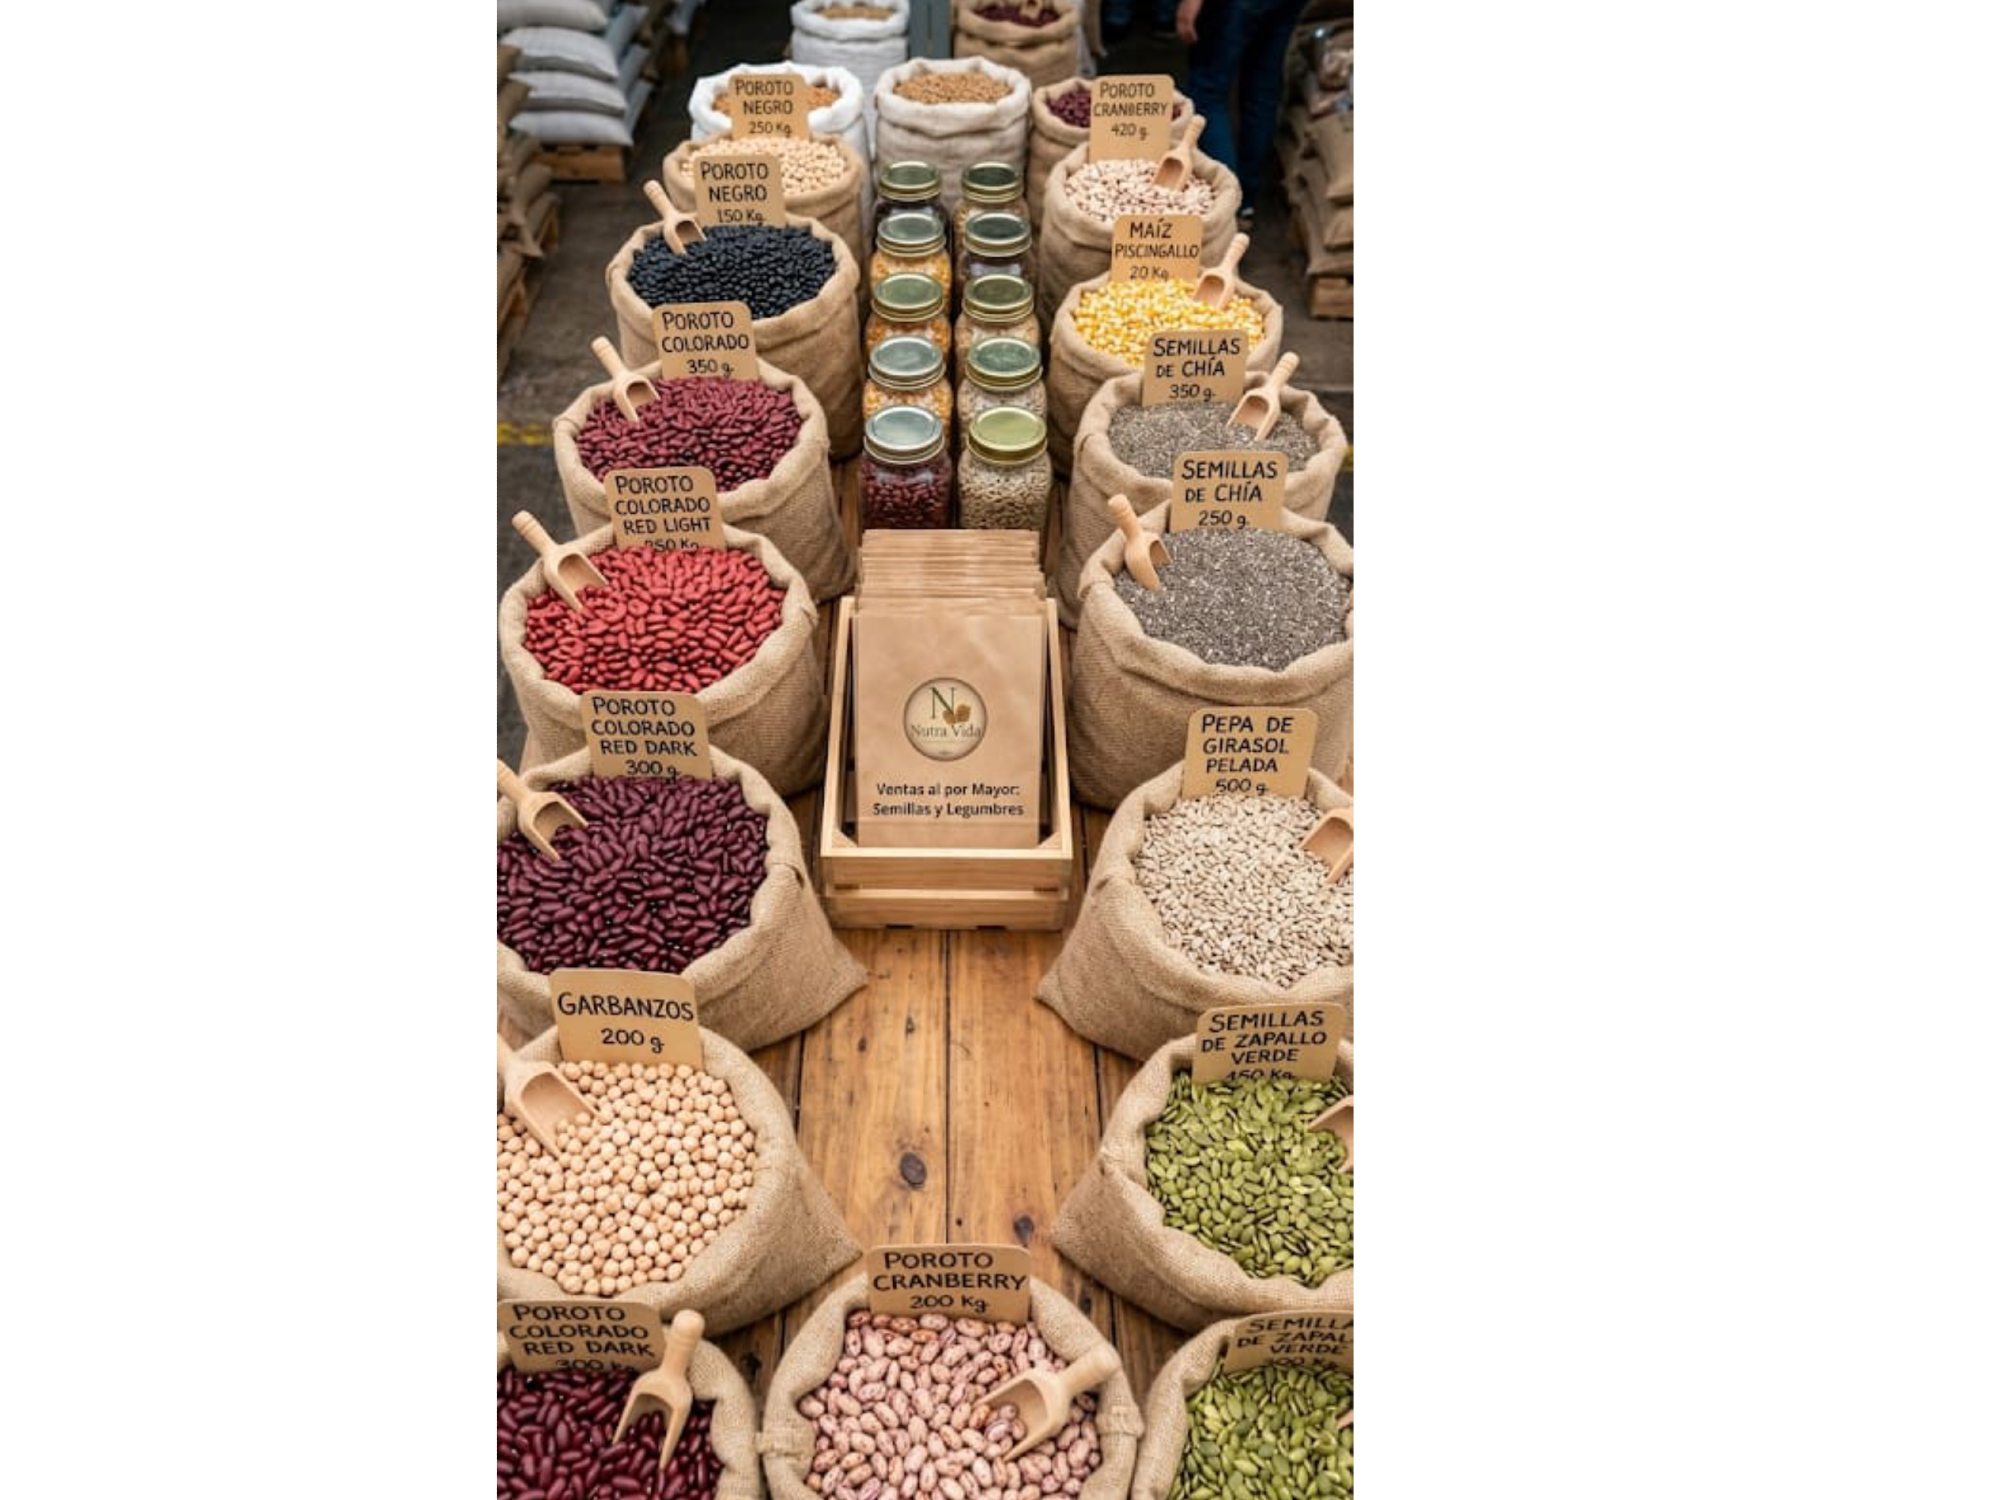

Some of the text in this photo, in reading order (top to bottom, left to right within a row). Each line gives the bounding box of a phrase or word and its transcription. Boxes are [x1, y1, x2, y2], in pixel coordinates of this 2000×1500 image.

[735, 79, 794, 96] POROTO
[1099, 82, 1154, 98] POROTO
[743, 100, 793, 115] NEGRO
[1093, 103, 1168, 117] CRANBERRY
[749, 122, 773, 134] 250
[1111, 123, 1137, 136] 420
[700, 161, 769, 180] POROTO
[708, 184, 767, 202] NEGRO
[717, 209, 743, 223] 150
[1129, 218, 1172, 238] MAÍZ
[1114, 243, 1199, 258] PISCINGALLO
[1130, 266, 1149, 279] 20
[661, 312, 734, 330] POROTO
[661, 334, 749, 353] COLORADO
[1153, 338, 1240, 357] SEMILLAS
[687, 360, 717, 374] 350
[1156, 356, 1225, 378] DE CHÍA
[1169, 384, 1200, 399] 350
[1181, 459, 1278, 480] SEMILLAS
[615, 475, 694, 494] POROTO
[1185, 481, 1263, 503] DE CHÍA
[615, 497, 710, 515] COLORADO
[623, 517, 711, 535] RED LIGHT
[1198, 510, 1233, 526] 250
[592, 696, 676, 716] POROTO
[591, 719, 695, 736] COLORADO
[911, 724, 982, 738] Nutra Vida
[1201, 713, 1295, 733] PEPA DE
[600, 739, 698, 757] RED DARK
[1202, 737, 1289, 755] GIRASOL
[625, 759, 664, 776] 300
[1206, 758, 1278, 773] PELADA
[876, 783, 1021, 799] Ventas al por Mayor:
[1215, 778, 1252, 793] 500
[873, 803, 1024, 819] Semillas y Legumbres
[557, 991, 694, 1021] GARBANZOS
[1209, 1010, 1324, 1033] SEMILLAS
[601, 1028, 644, 1045] 200
[1201, 1031, 1327, 1052] DE ZAPALLO
[1231, 1048, 1300, 1065] VERDE
[884, 1252, 994, 1269] POROTO
[873, 1274, 1026, 1291] CRANBERRY
[909, 1294, 954, 1309] 200
[512, 1304, 625, 1321] POROTO
[509, 1325, 648, 1339] COLORADO
[523, 1341, 655, 1357] RED DARK
[1237, 1334, 1265, 1348] DE
[1270, 1343, 1348, 1355] VERDE
